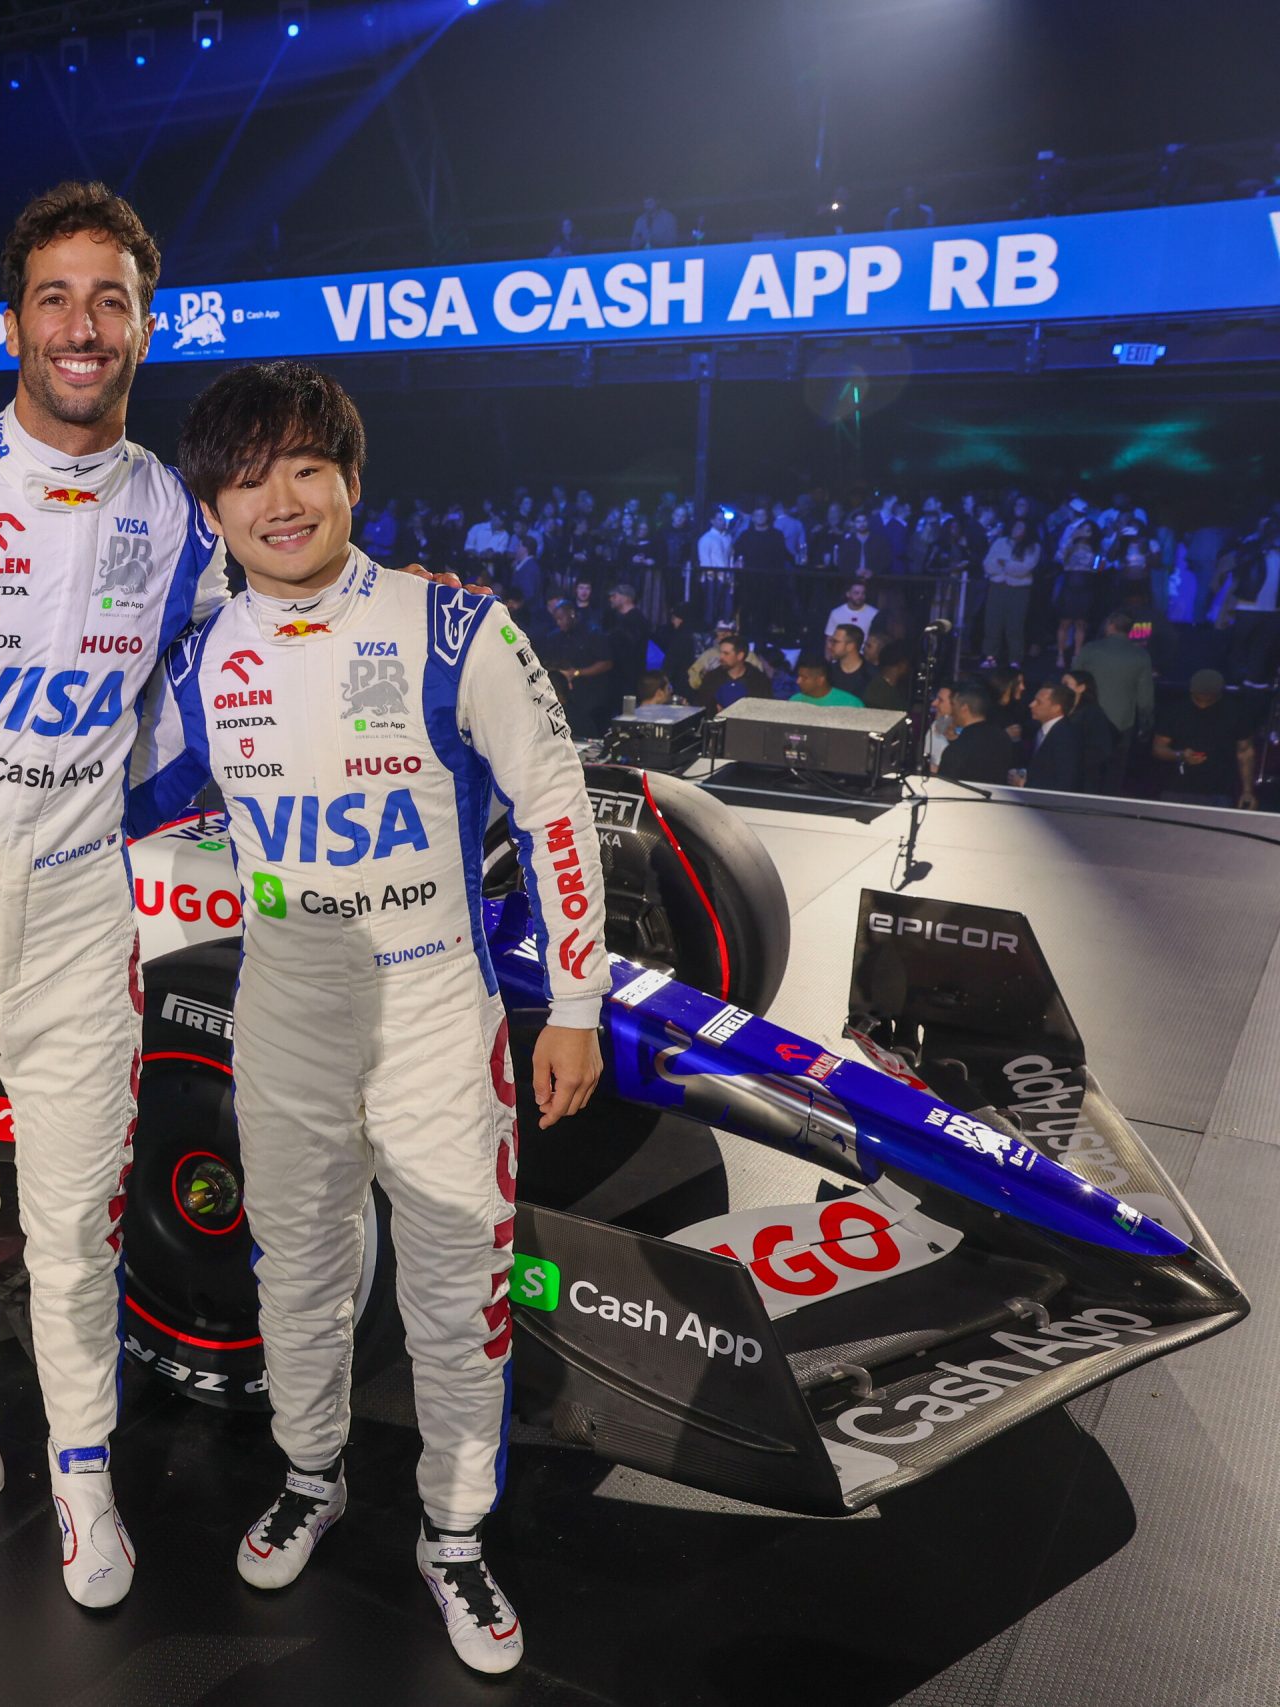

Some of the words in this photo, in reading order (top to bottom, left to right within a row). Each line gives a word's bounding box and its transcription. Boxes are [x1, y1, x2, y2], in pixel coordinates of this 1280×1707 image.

[322, 277, 478, 342] VISA
[493, 258, 705, 334] CASH
[727, 245, 902, 322] APP
[929, 233, 1059, 312] RB
[1126, 346, 1152, 361] EXIT
[113, 516, 149, 536] VISA
[116, 599, 129, 607] Cash
[131, 601, 144, 609] App
[81, 635, 143, 654] HUGO
[353, 642, 398, 656] VISA
[214, 689, 273, 710] ORLEN
[216, 716, 277, 730] HONDA
[390, 722, 406, 730] App
[60, 760, 104, 787] App
[224, 763, 285, 779] TUDOR
[344, 755, 422, 778] HUGO
[233, 788, 429, 867] VISA
[33, 839, 101, 870] RICCIARDO
[545, 816, 589, 920] ORLEN
[300, 889, 371, 919] Cash
[381, 880, 437, 910] App
[374, 939, 446, 967] TSUNODA
[695, 1003, 754, 1048] PIRELLI
[807, 1052, 839, 1079] ORLEN
[1002, 1054, 1086, 1114] App
[924, 1107, 950, 1127] VISA
[713, 1202, 901, 1304] GO
[568, 1280, 668, 1336] Cash
[675, 1311, 763, 1367] App
[836, 1360, 1044, 1445] Cash
[990, 1308, 1157, 1366] App
